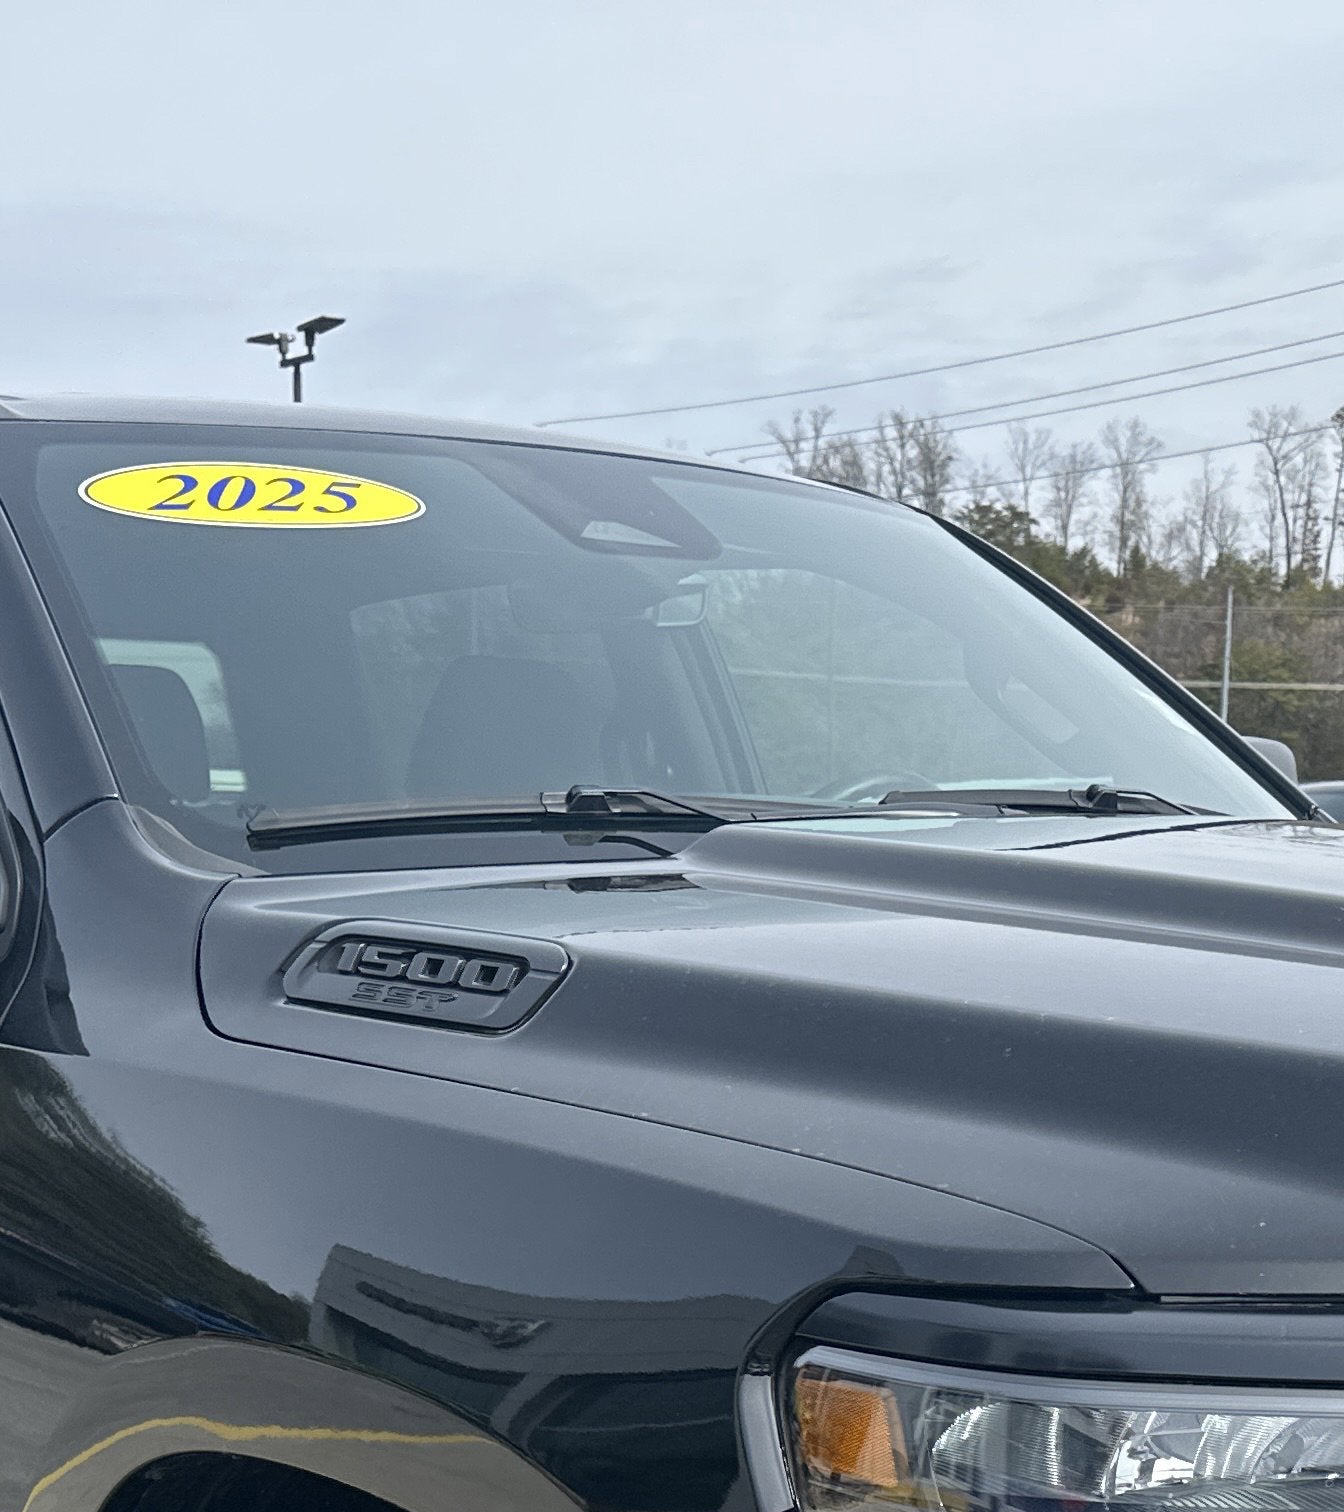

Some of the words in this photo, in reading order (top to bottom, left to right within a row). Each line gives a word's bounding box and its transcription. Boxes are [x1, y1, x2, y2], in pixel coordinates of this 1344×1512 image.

[147, 473, 362, 514] 2025
[336, 942, 518, 994] 1500
[351, 981, 459, 1013] SST
